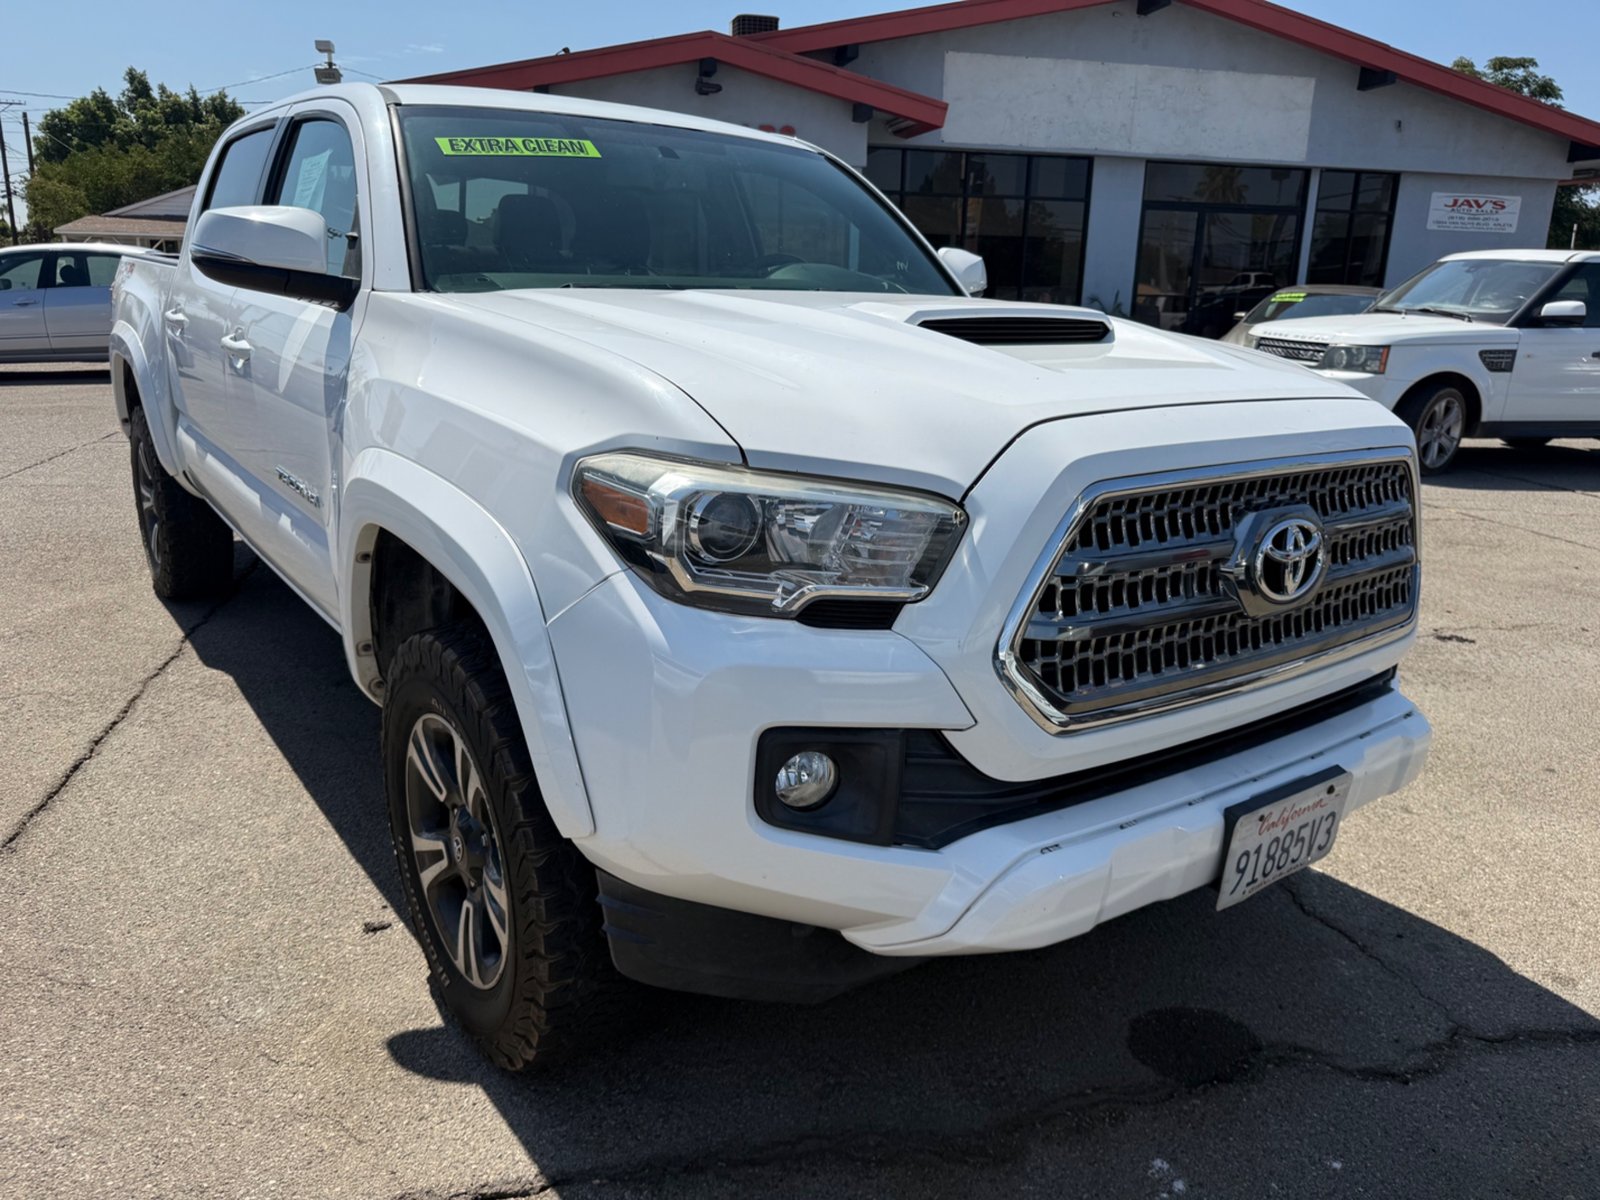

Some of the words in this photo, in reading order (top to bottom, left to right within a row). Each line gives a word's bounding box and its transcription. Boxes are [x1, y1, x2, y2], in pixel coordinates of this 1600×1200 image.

[448, 138, 520, 154] EXTRA
[521, 138, 587, 155] CLEAN
[1229, 811, 1336, 896] 91885V3
